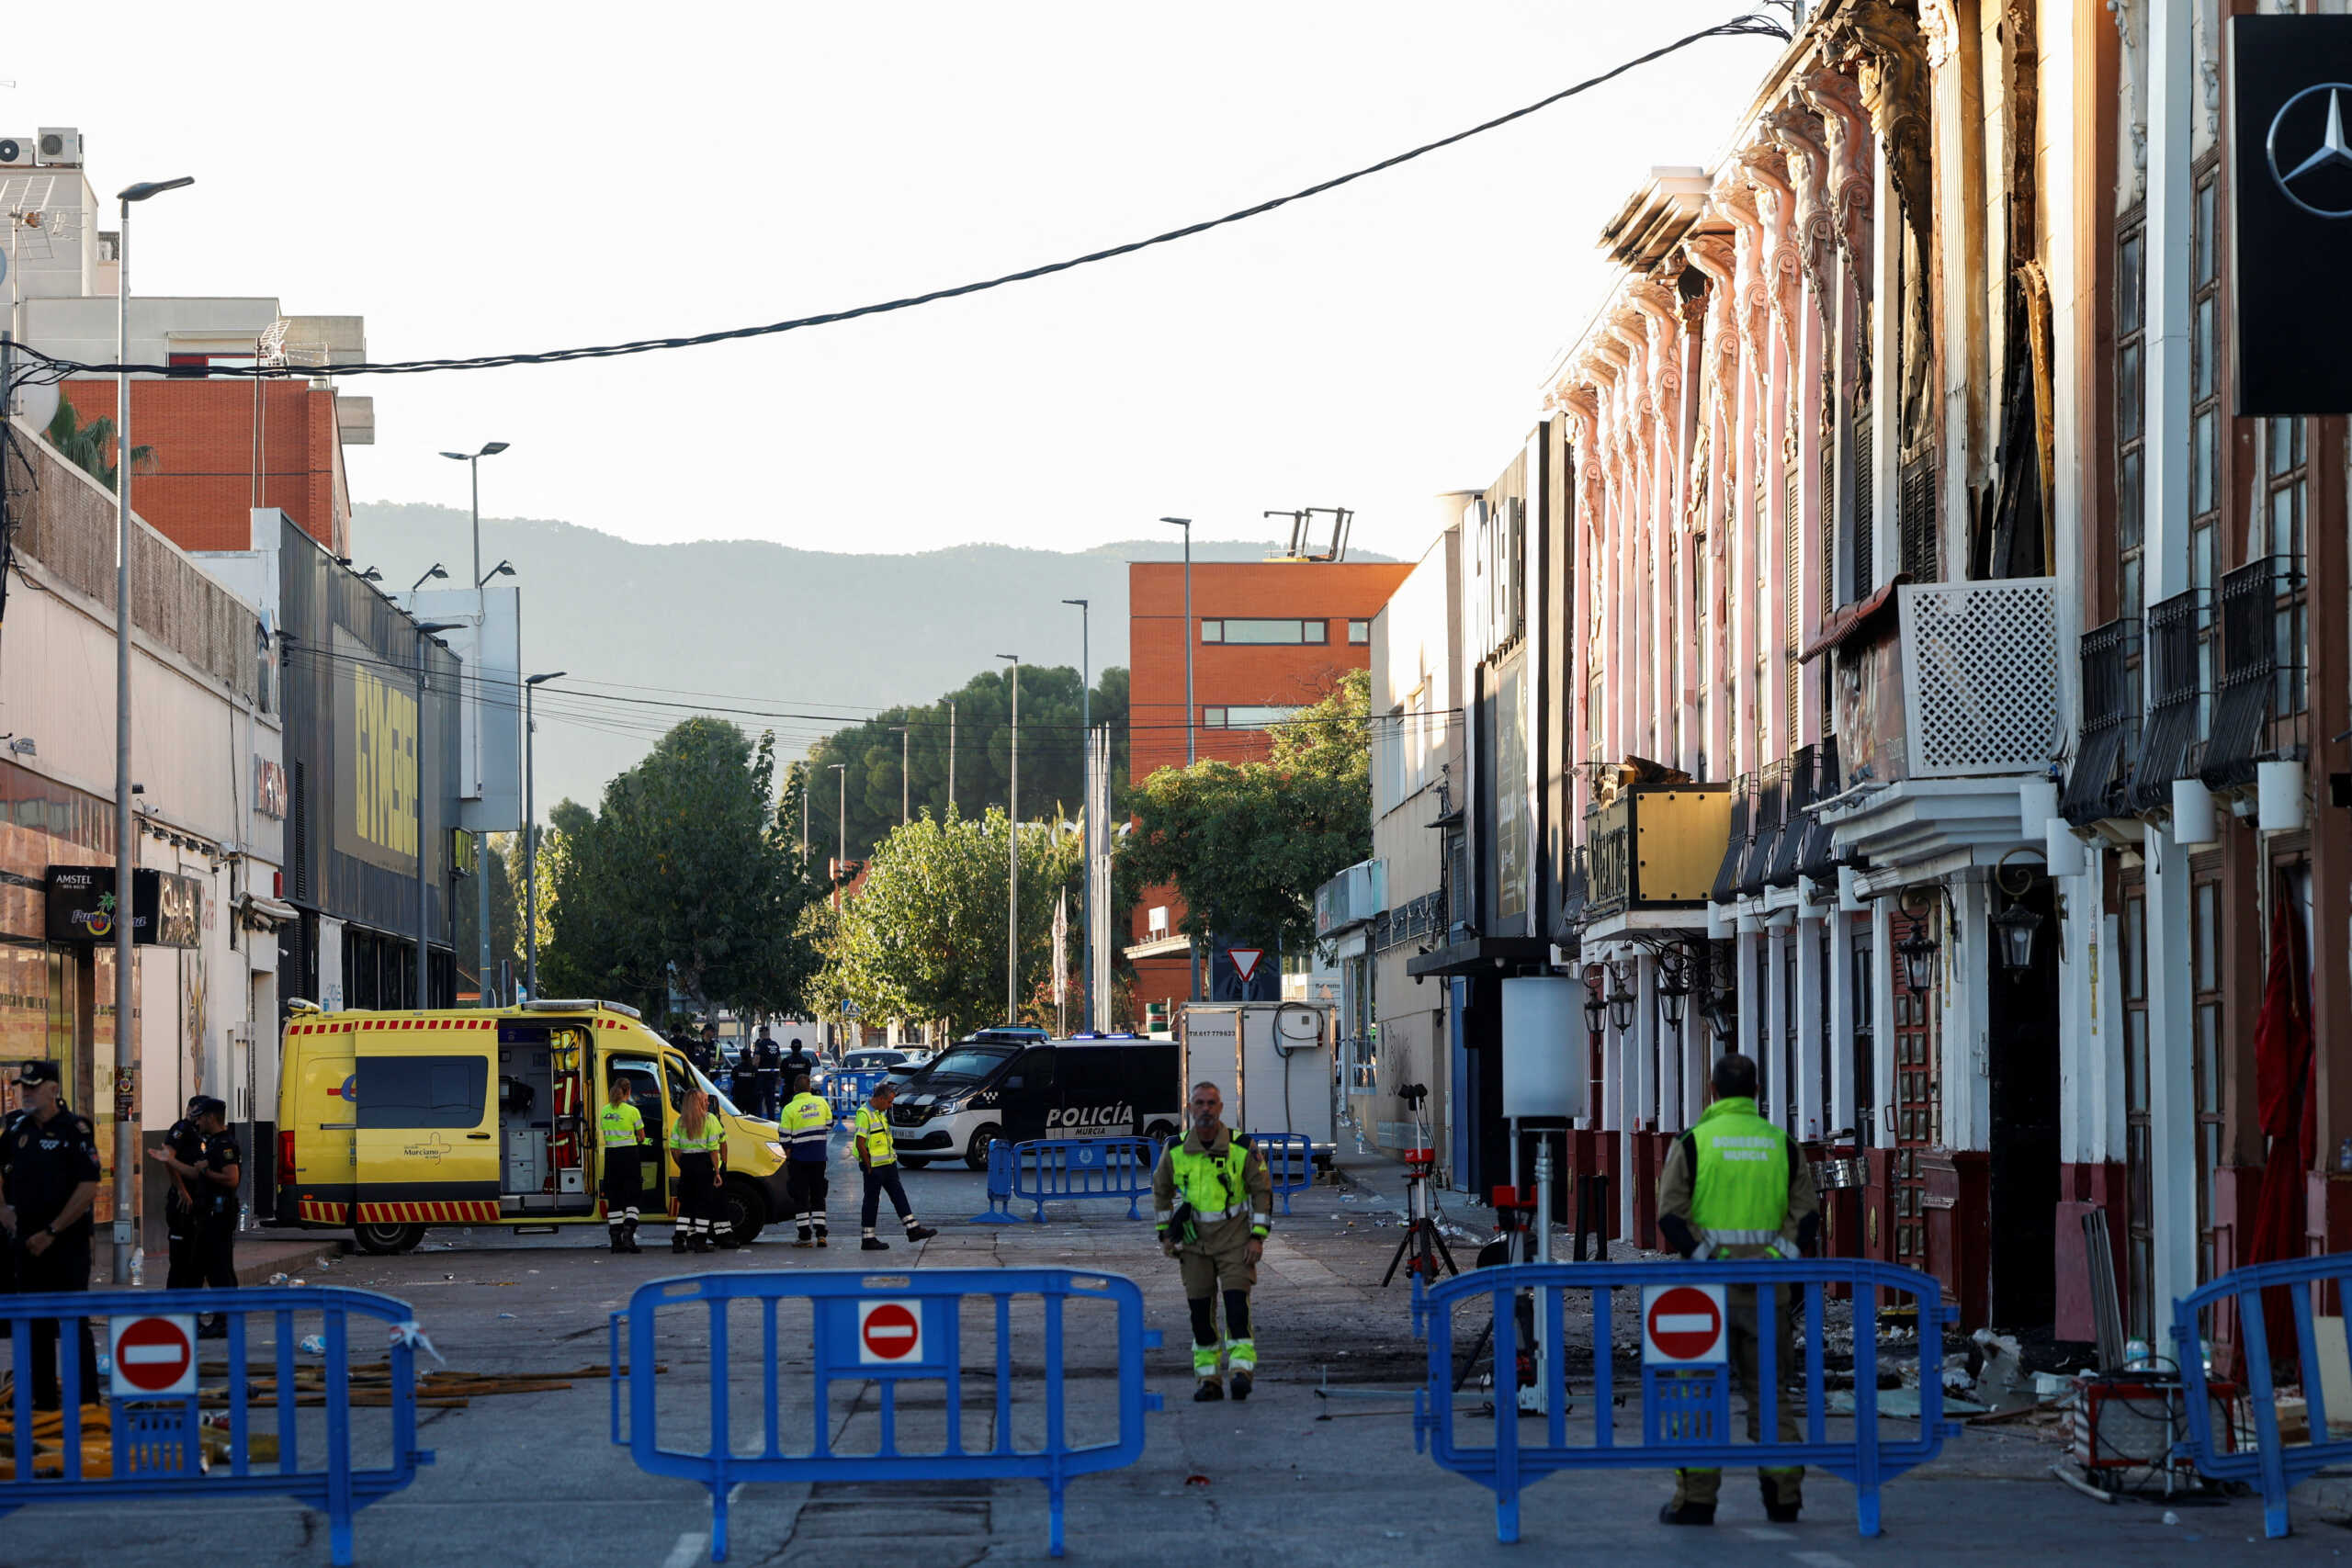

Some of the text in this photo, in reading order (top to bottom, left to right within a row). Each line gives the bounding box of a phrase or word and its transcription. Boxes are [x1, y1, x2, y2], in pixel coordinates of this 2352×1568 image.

[56, 874, 92, 885] AMSTEL
[1046, 1100, 1134, 1127] POLICÍA
[1076, 1126, 1105, 1136] MURCIA
[1713, 1136, 1776, 1148] BOMBEROS
[1724, 1151, 1769, 1162] MURCIA
